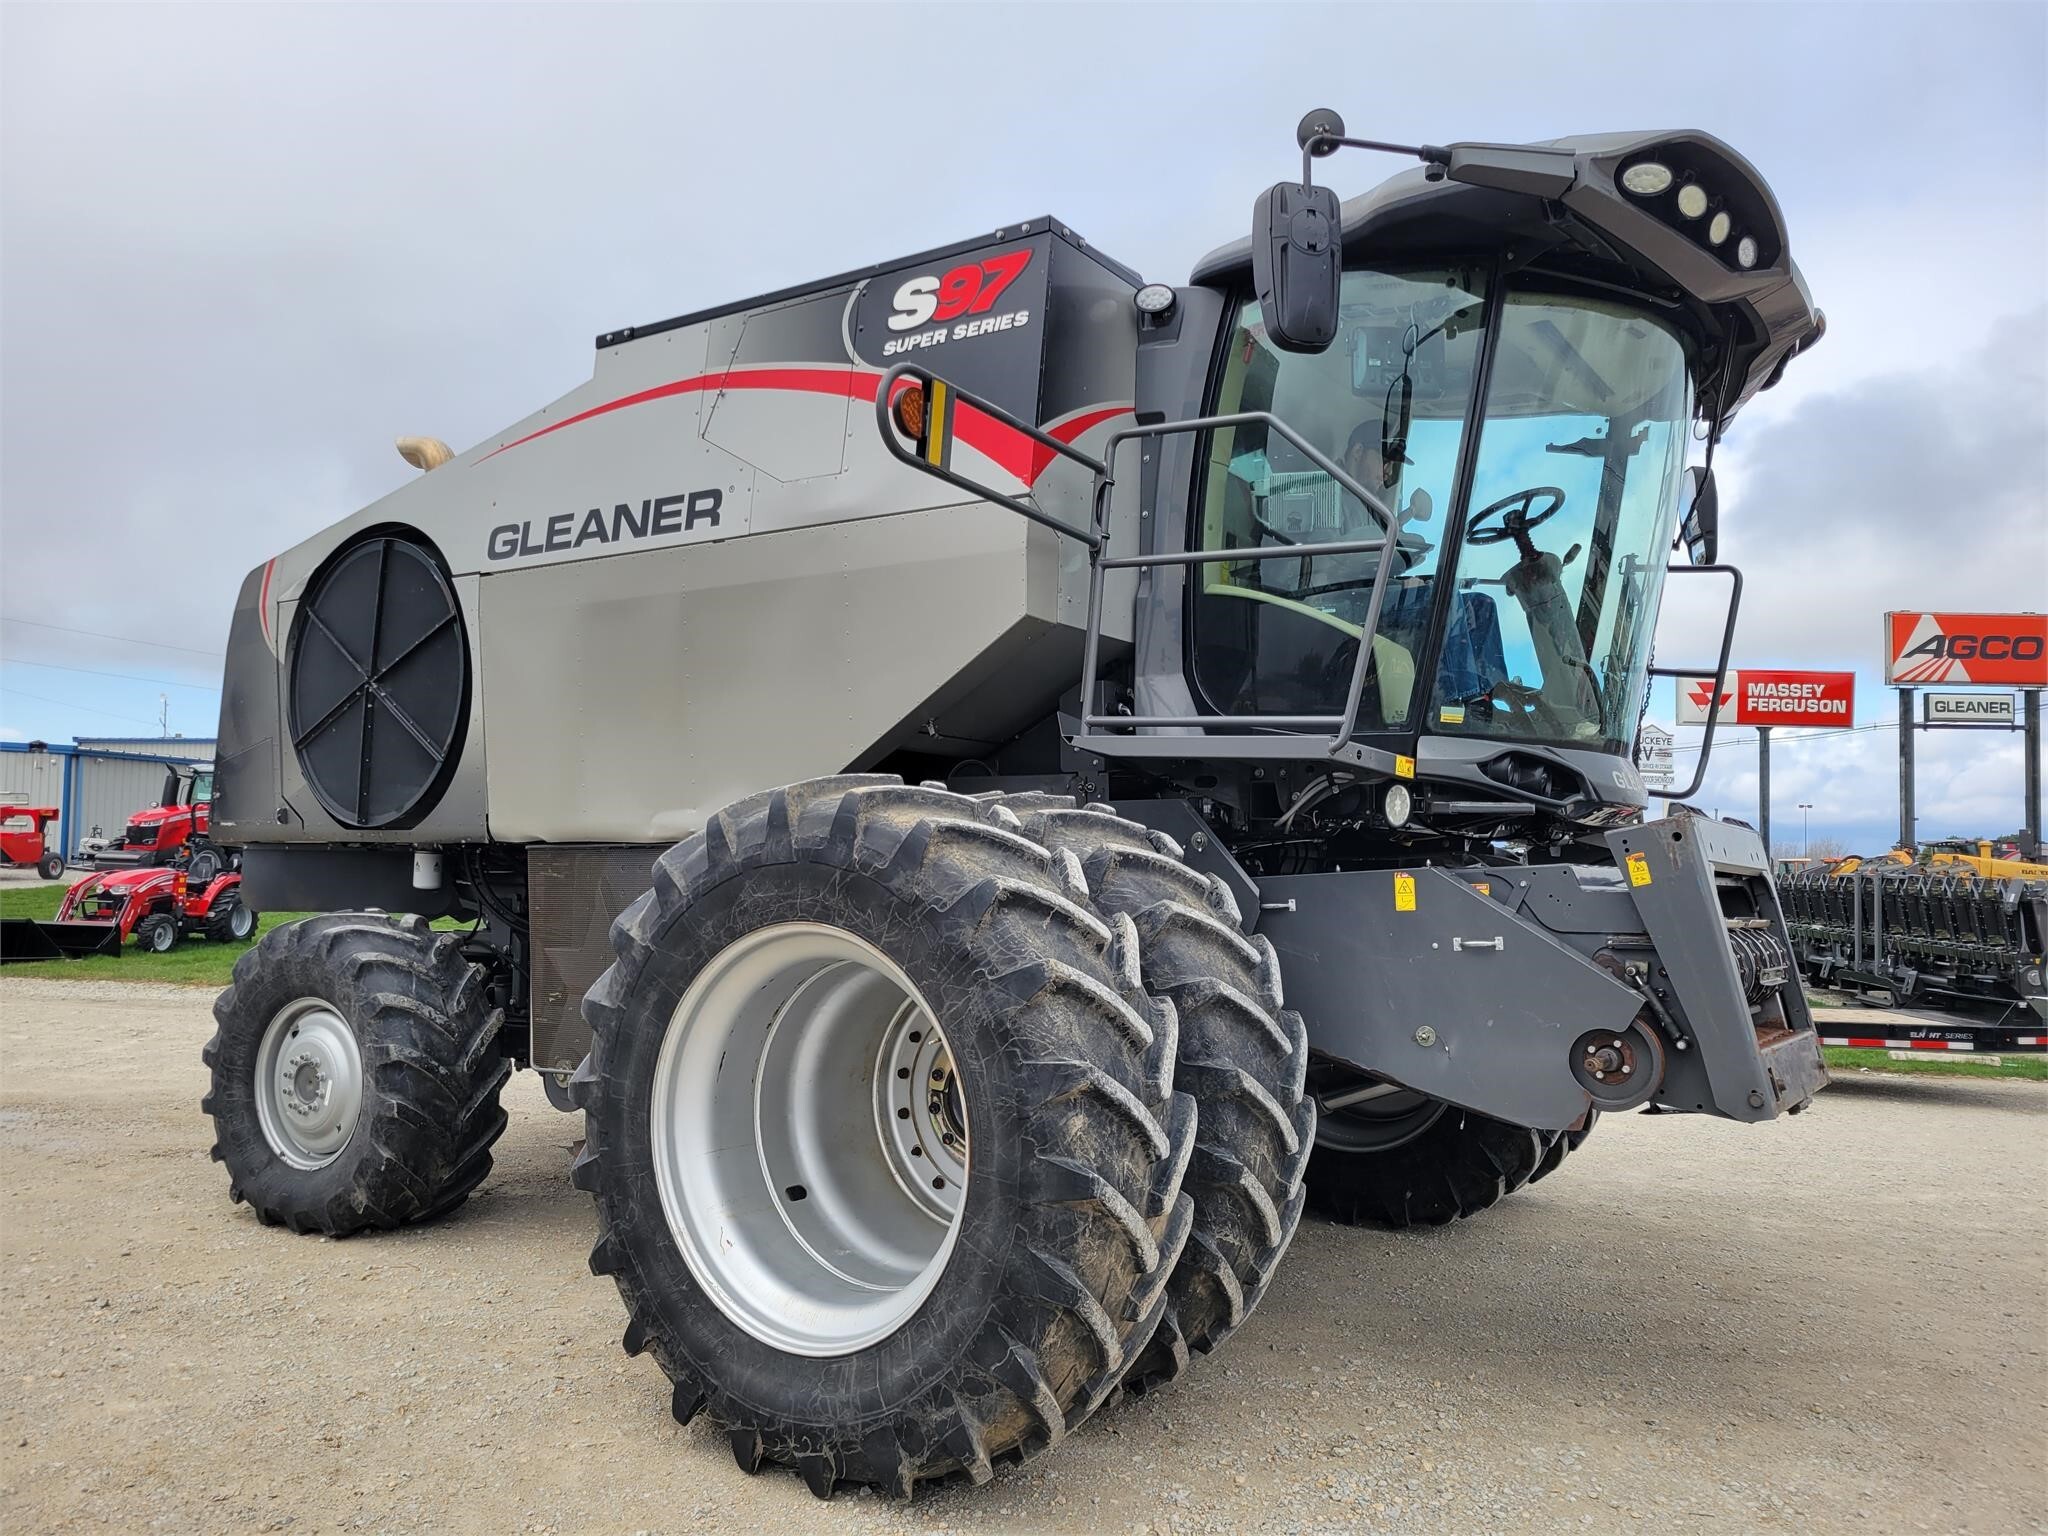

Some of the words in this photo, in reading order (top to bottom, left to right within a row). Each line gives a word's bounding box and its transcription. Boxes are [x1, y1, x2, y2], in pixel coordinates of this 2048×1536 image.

[888, 248, 1034, 331] S97
[882, 328, 948, 356] SUPER
[952, 310, 1030, 340] SERIES
[487, 488, 723, 561] GLEANER
[1901, 634, 2045, 660] AGCO
[1747, 682, 1826, 698] MASSEY
[1747, 698, 1847, 714] FERGUSON
[1934, 700, 2011, 714] GLEANER
[1639, 736, 1673, 746] UCKEYE
[1639, 746, 1654, 762] V
